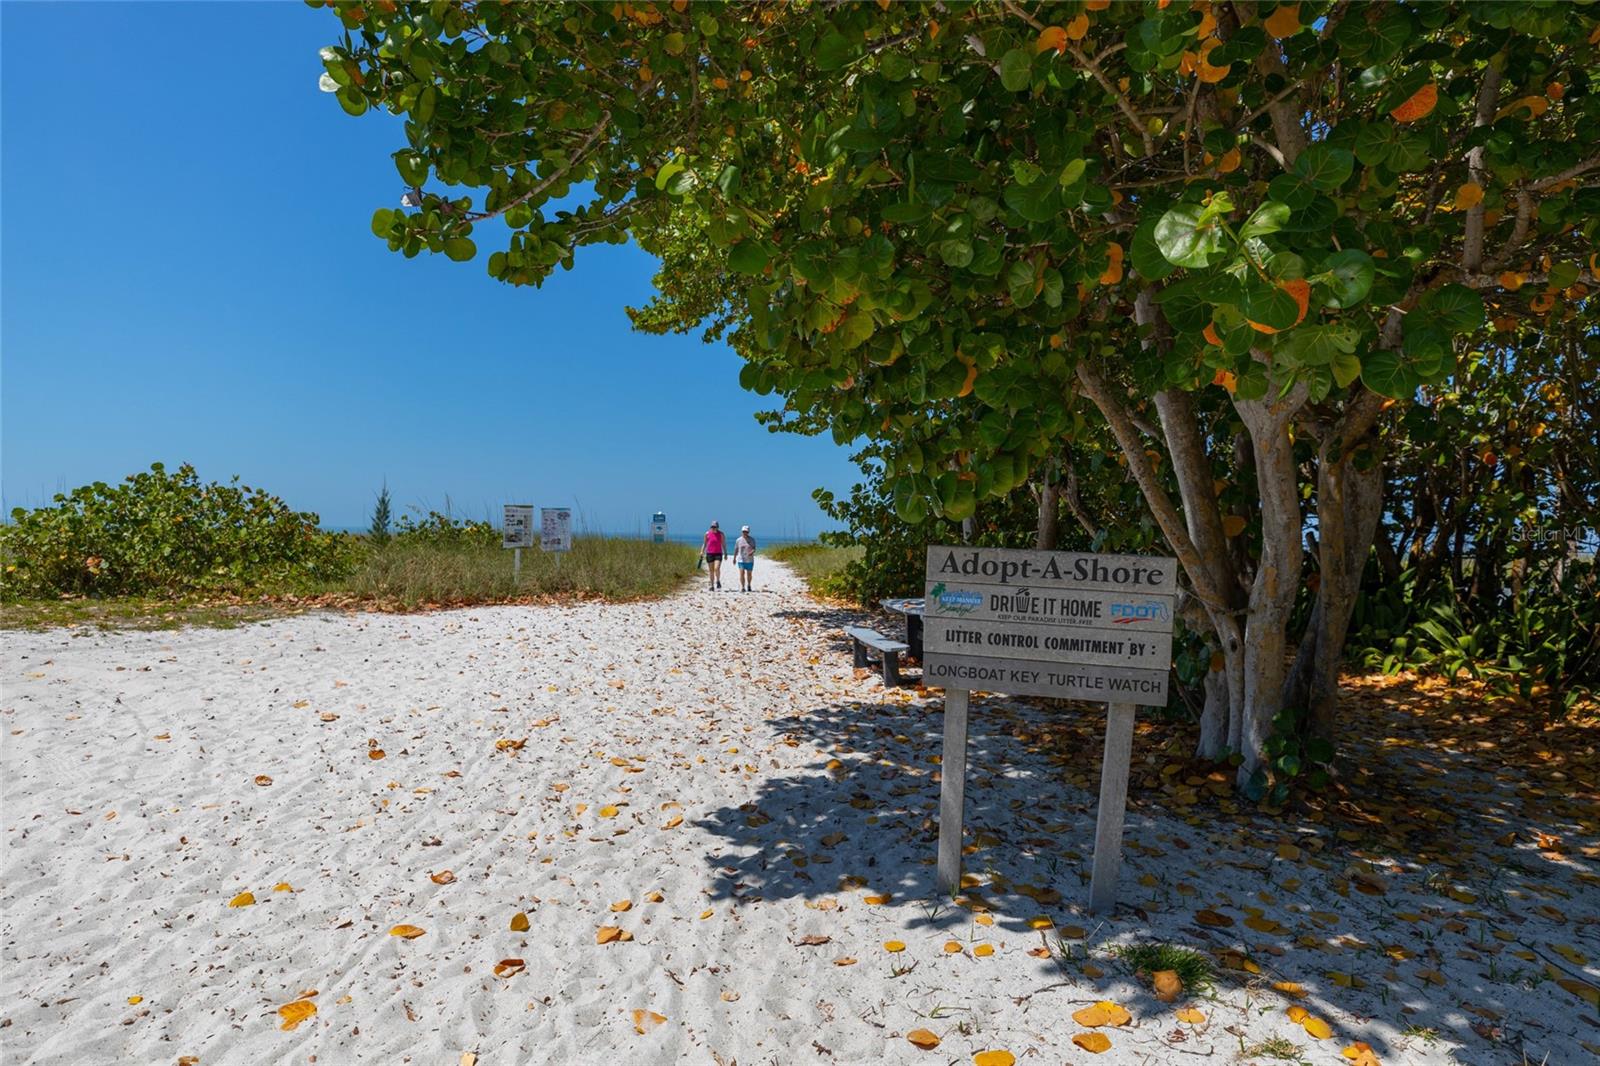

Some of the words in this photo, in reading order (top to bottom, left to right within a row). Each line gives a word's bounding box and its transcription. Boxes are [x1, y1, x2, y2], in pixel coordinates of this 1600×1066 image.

[939, 550, 1164, 586] Adopt-A-Shore
[1043, 597, 1057, 615] IT
[1060, 599, 1102, 618] HOME
[1110, 603, 1161, 619] FDOT
[946, 629, 982, 645] LITTER
[988, 632, 1040, 650] CONTROL
[1044, 635, 1124, 655] COMMITMENT
[1129, 643, 1146, 656] BY
[929, 664, 1006, 682] LONGBOAT
[1010, 669, 1040, 684] KEY
[1048, 673, 1103, 689] TURTLE
[1108, 677, 1161, 693] WATCH
